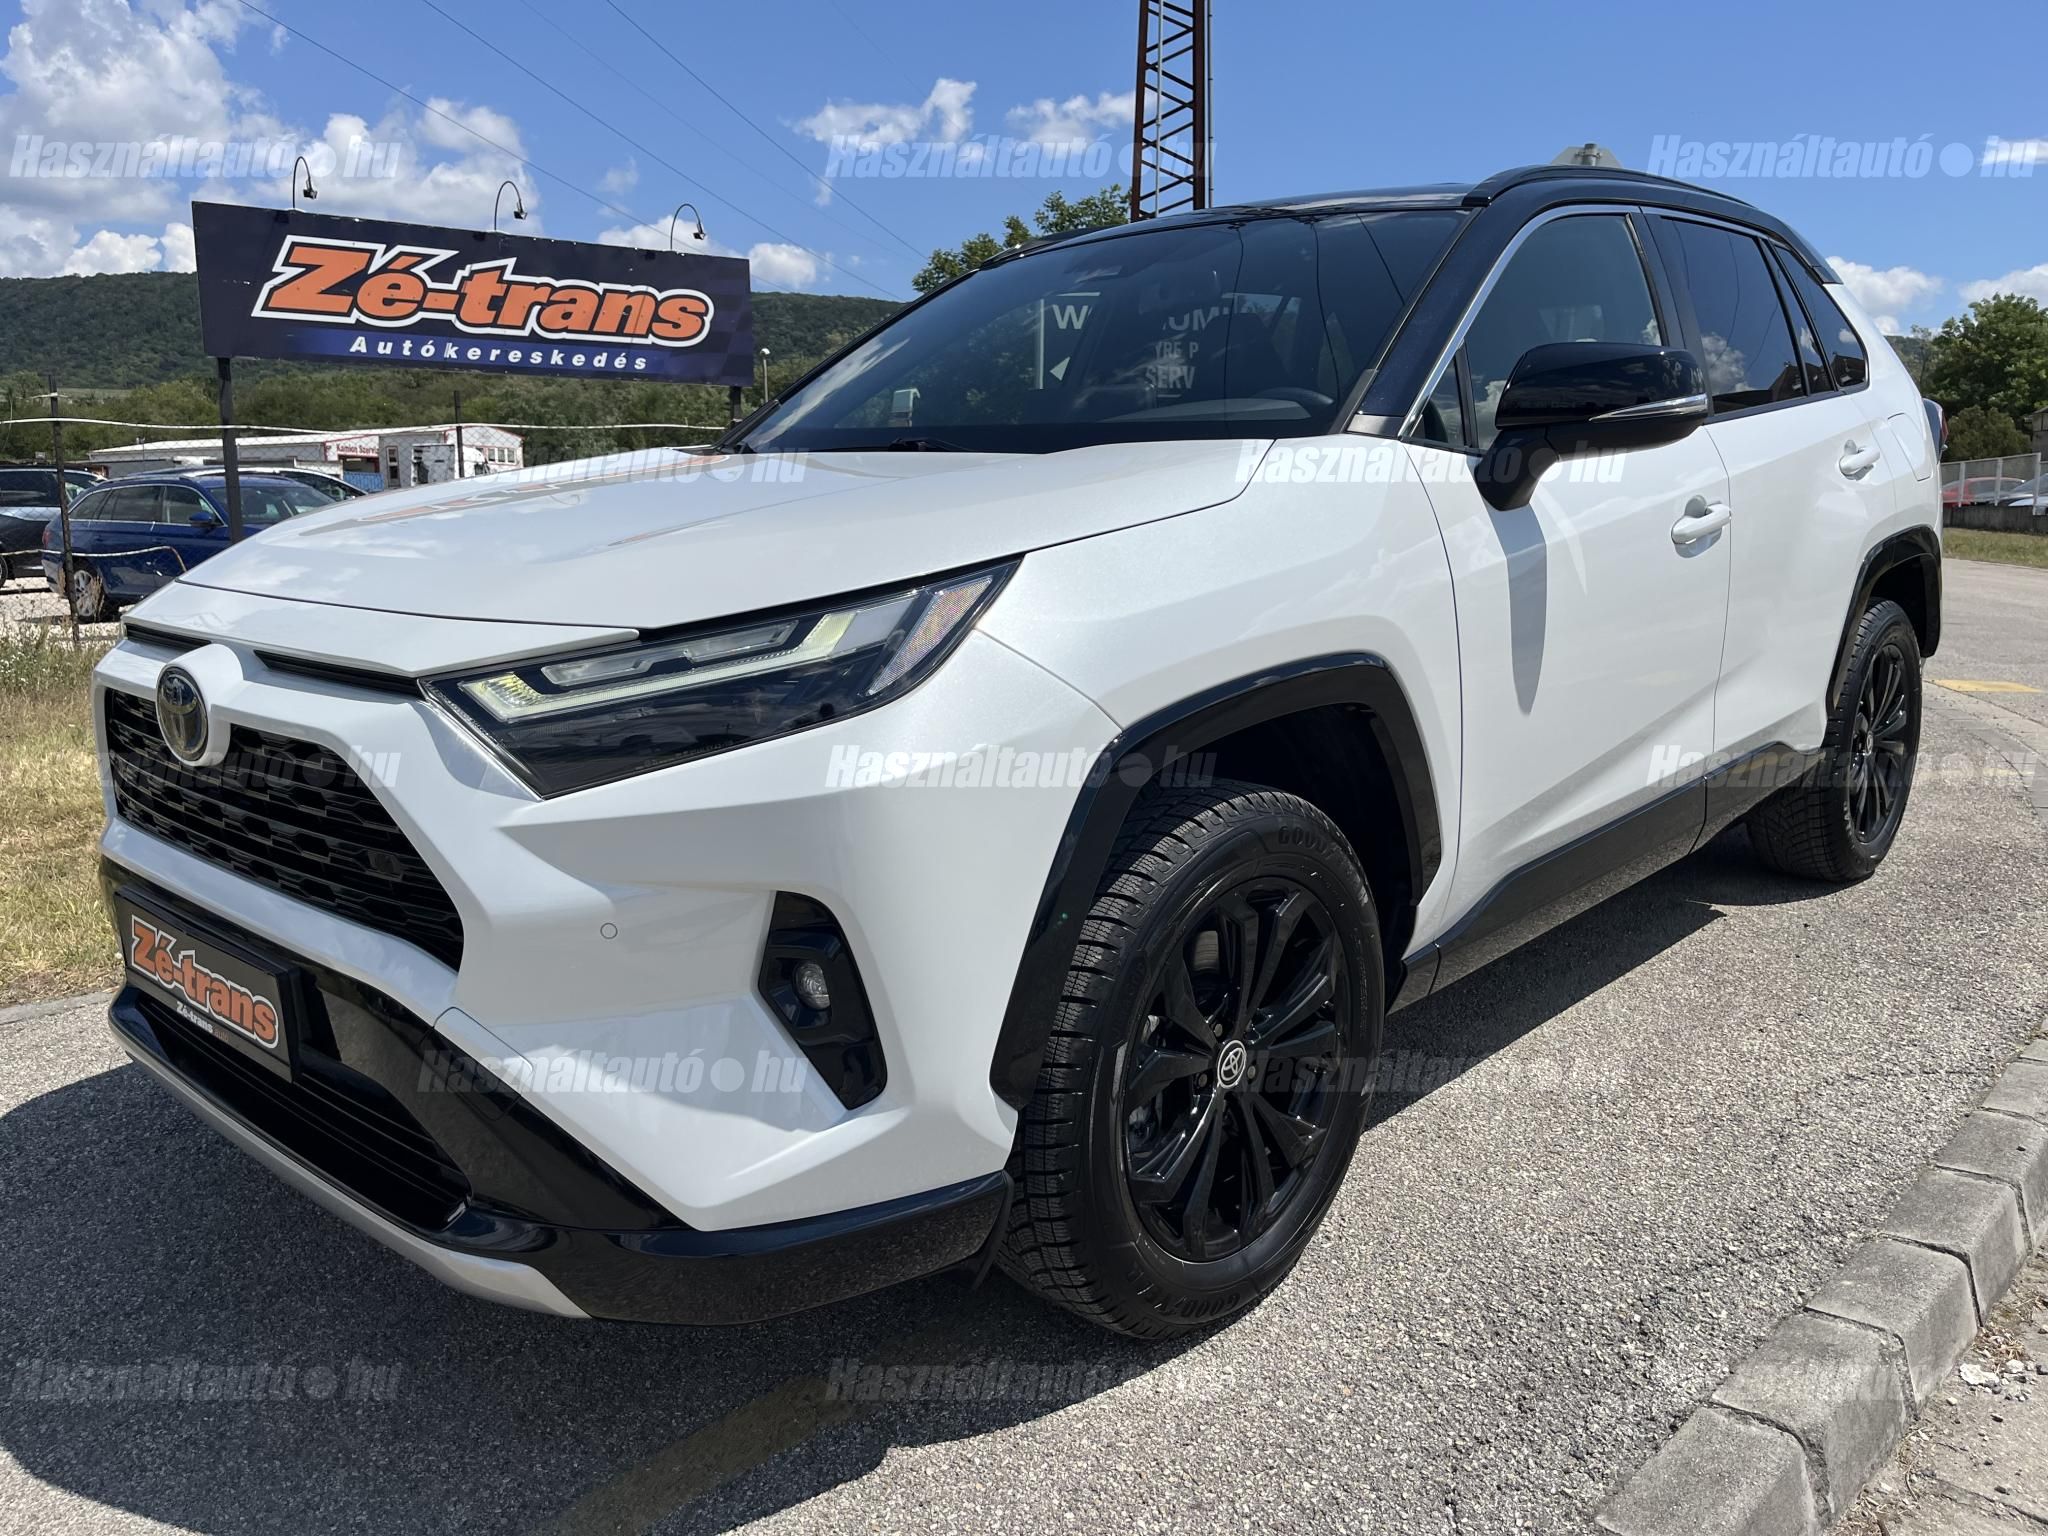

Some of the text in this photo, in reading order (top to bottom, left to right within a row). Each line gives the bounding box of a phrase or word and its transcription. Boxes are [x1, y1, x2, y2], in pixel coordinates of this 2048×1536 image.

[252, 235, 714, 347] Zé-trans
[349, 336, 648, 370] Autókereskedés
[131, 914, 279, 1048] Zé-trans
